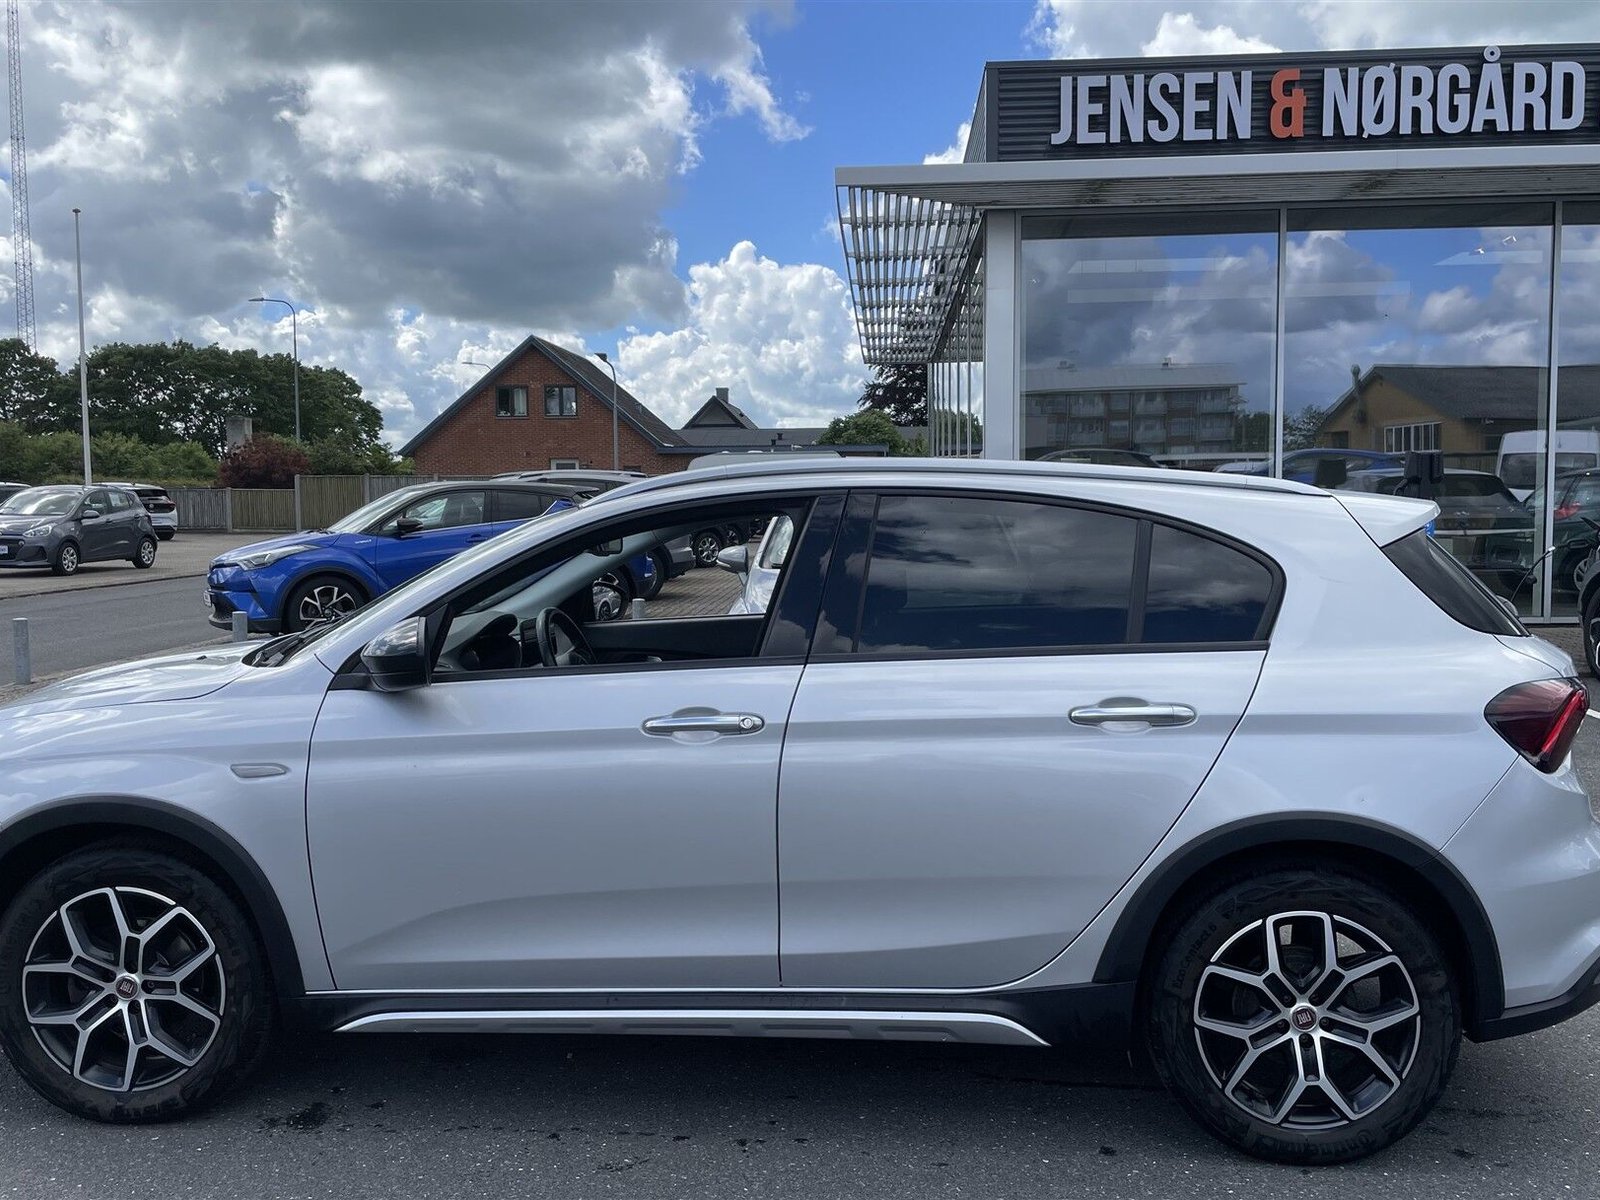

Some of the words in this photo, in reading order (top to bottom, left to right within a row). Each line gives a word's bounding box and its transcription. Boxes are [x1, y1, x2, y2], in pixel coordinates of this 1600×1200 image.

[1051, 69, 1253, 145] JENSEN
[1269, 68, 1307, 139] &
[1321, 44, 1586, 139] NØRGÅRD
[1297, 1011, 1312, 1025] FIAT
